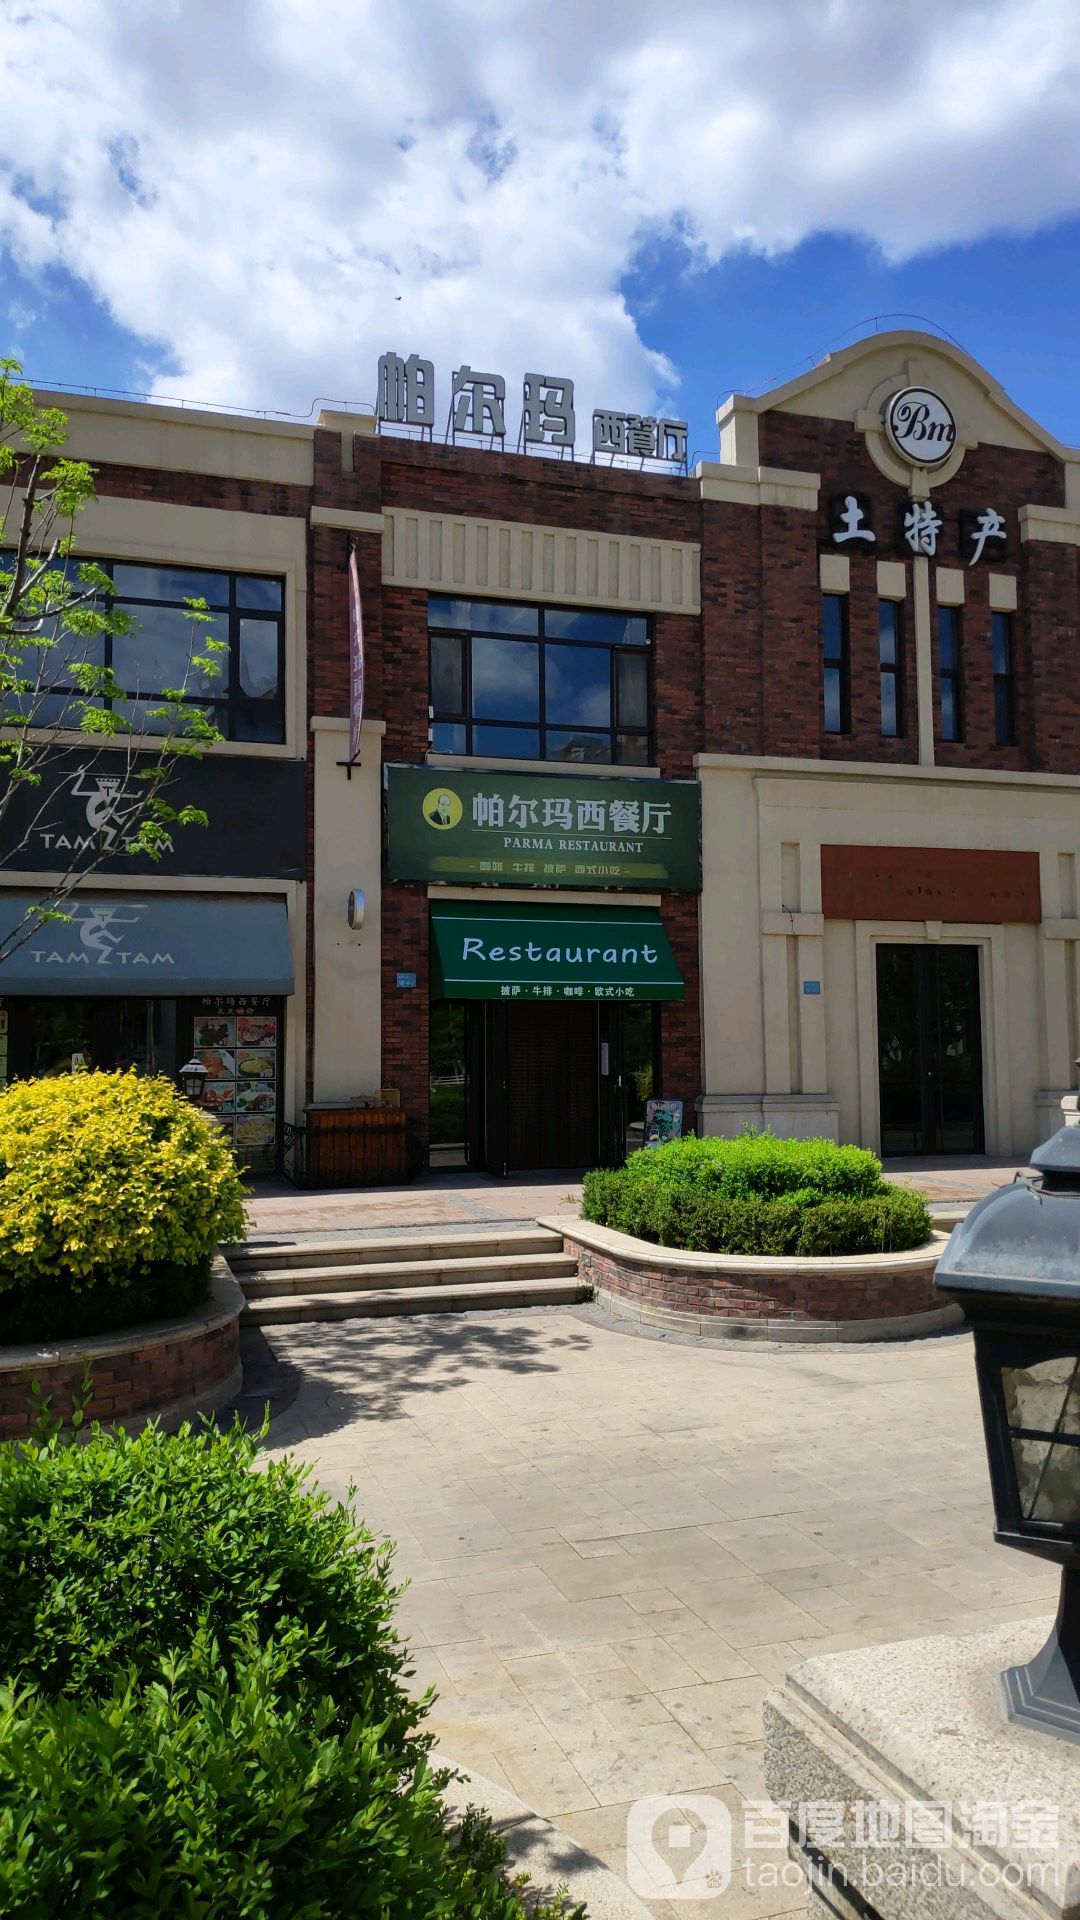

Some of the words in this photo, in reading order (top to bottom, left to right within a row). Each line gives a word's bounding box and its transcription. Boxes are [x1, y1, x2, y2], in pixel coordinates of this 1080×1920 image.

[378, 352, 576, 445] 帕尔玛
[593, 409, 688, 461] 西餐厅
[833, 496, 1007, 567] 土特产
[472, 792, 672, 834] 帕尔玛西餐厅
[40, 834, 96, 850] TAM
[122, 836, 175, 853] TM
[503, 837, 553, 850] PARMA
[559, 839, 644, 853] RESTAURANT
[31, 951, 89, 963] TAM
[116, 952, 175, 964] TAM
[462, 937, 658, 964] Restaurant
